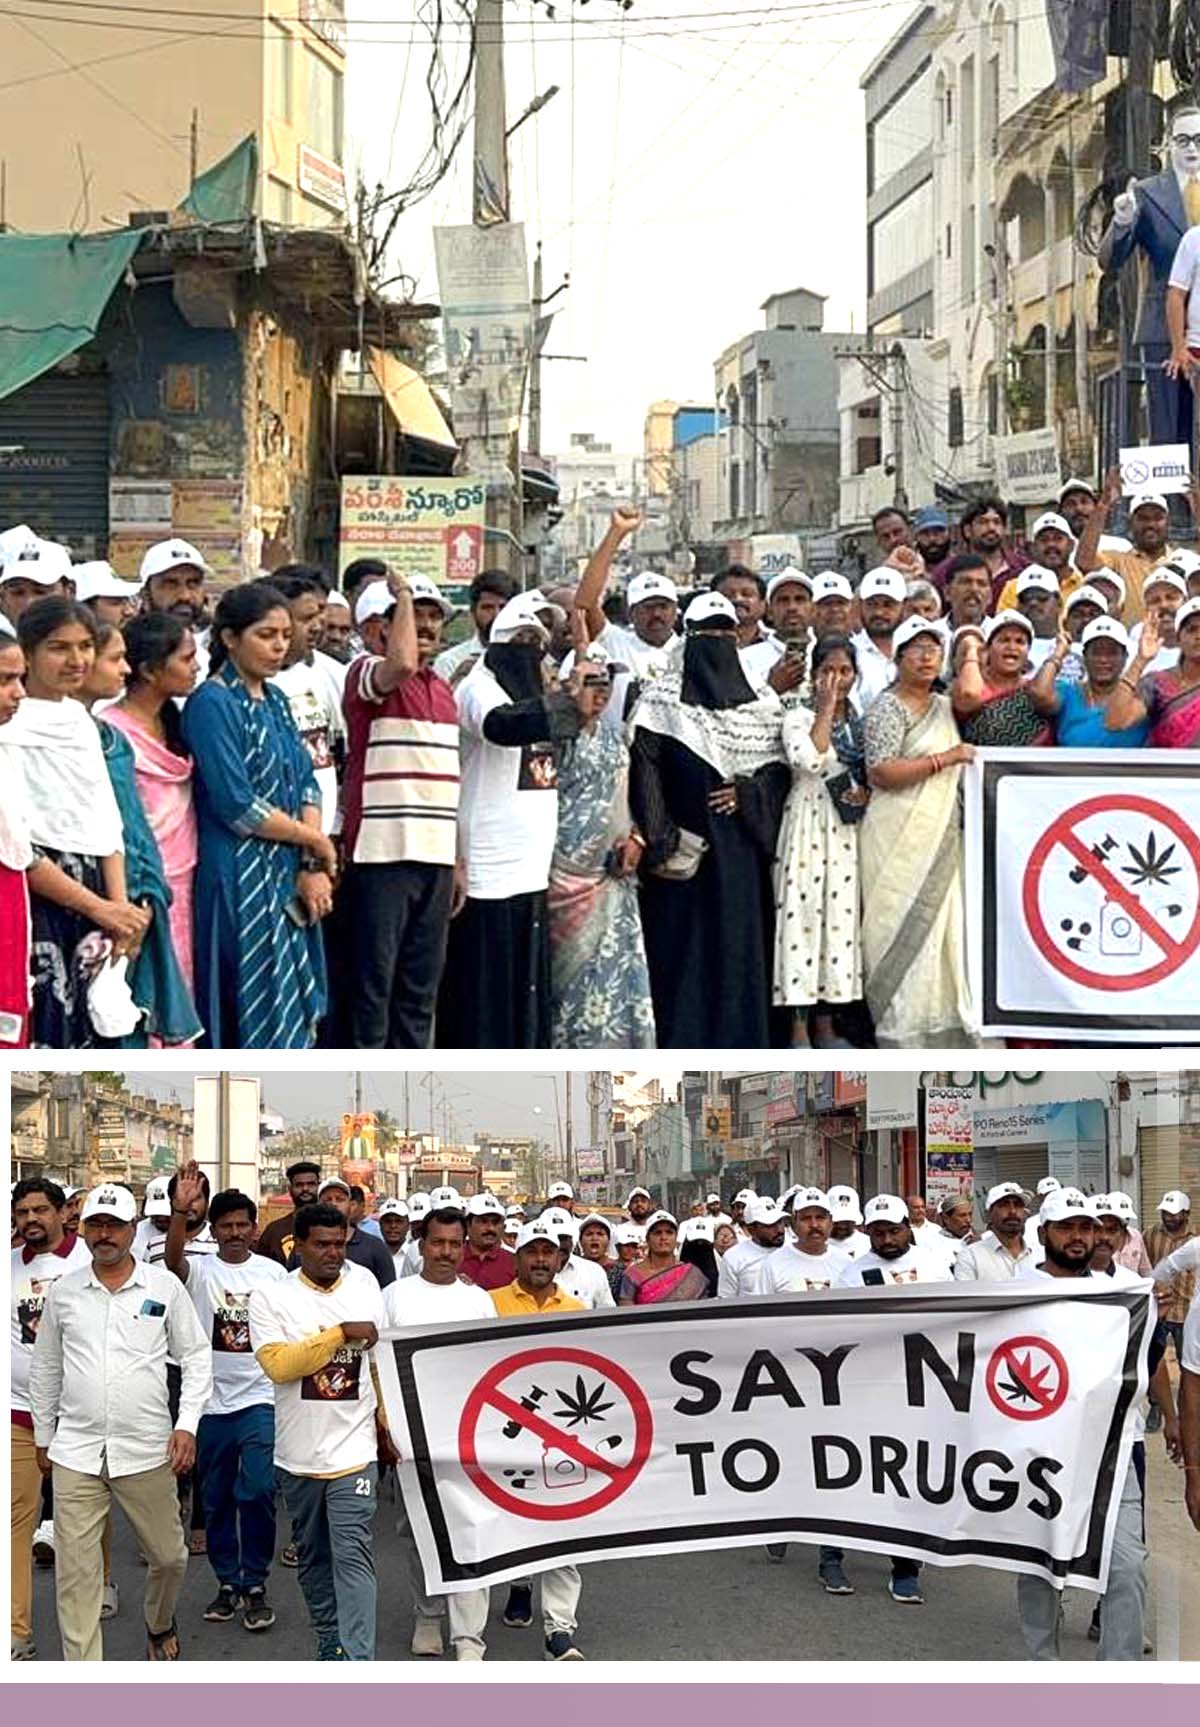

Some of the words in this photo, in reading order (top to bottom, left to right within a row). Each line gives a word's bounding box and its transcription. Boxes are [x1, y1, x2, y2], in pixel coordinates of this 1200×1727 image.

[332, 1354, 353, 1364] UGS
[669, 1343, 859, 1417] SAY
[355, 1478, 371, 1496] 23
[676, 1438, 780, 1497] TO
[810, 1434, 1064, 1521] DRUGS
